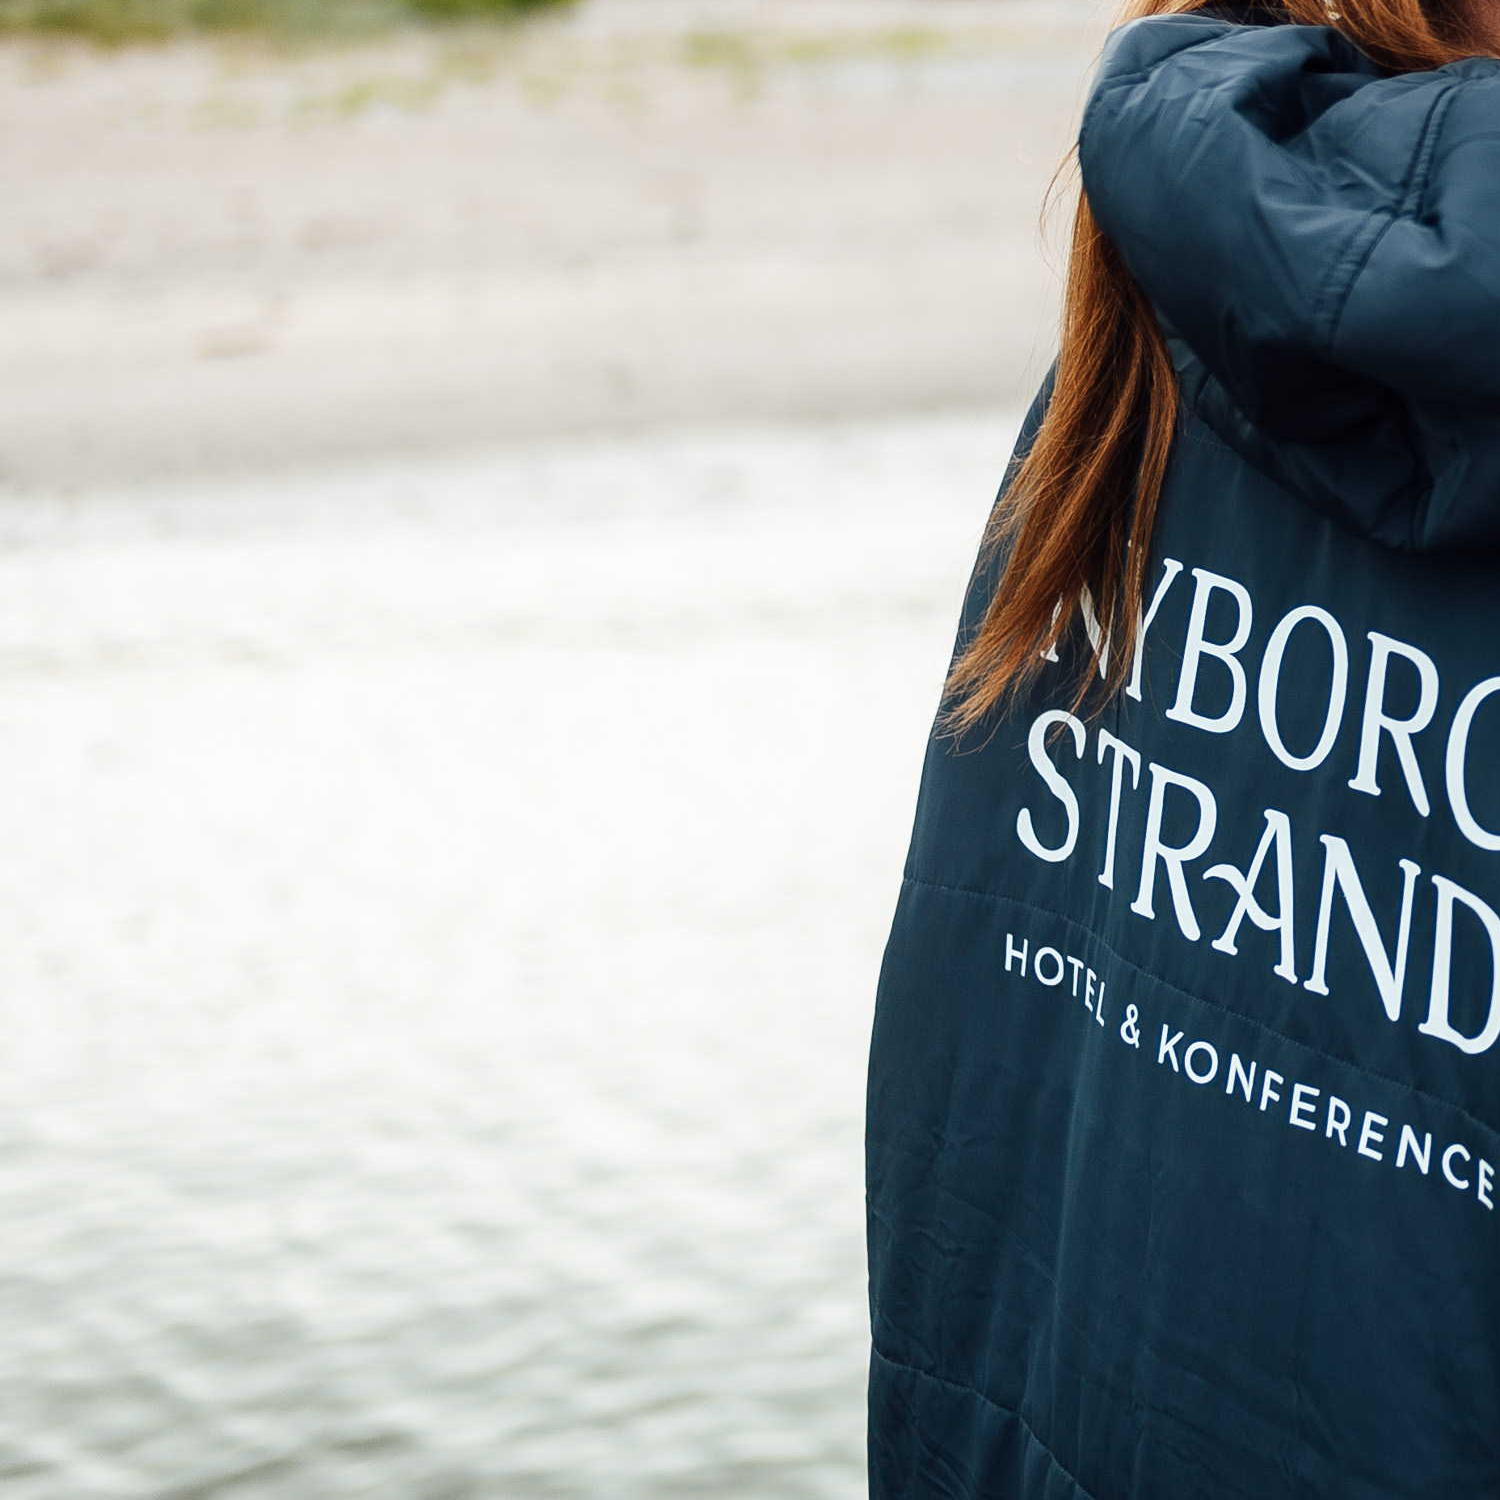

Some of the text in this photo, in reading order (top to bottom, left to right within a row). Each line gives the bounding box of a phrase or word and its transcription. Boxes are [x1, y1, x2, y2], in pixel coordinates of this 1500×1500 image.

[1005, 933, 1495, 1210] HOTEL & KONFERENCE
